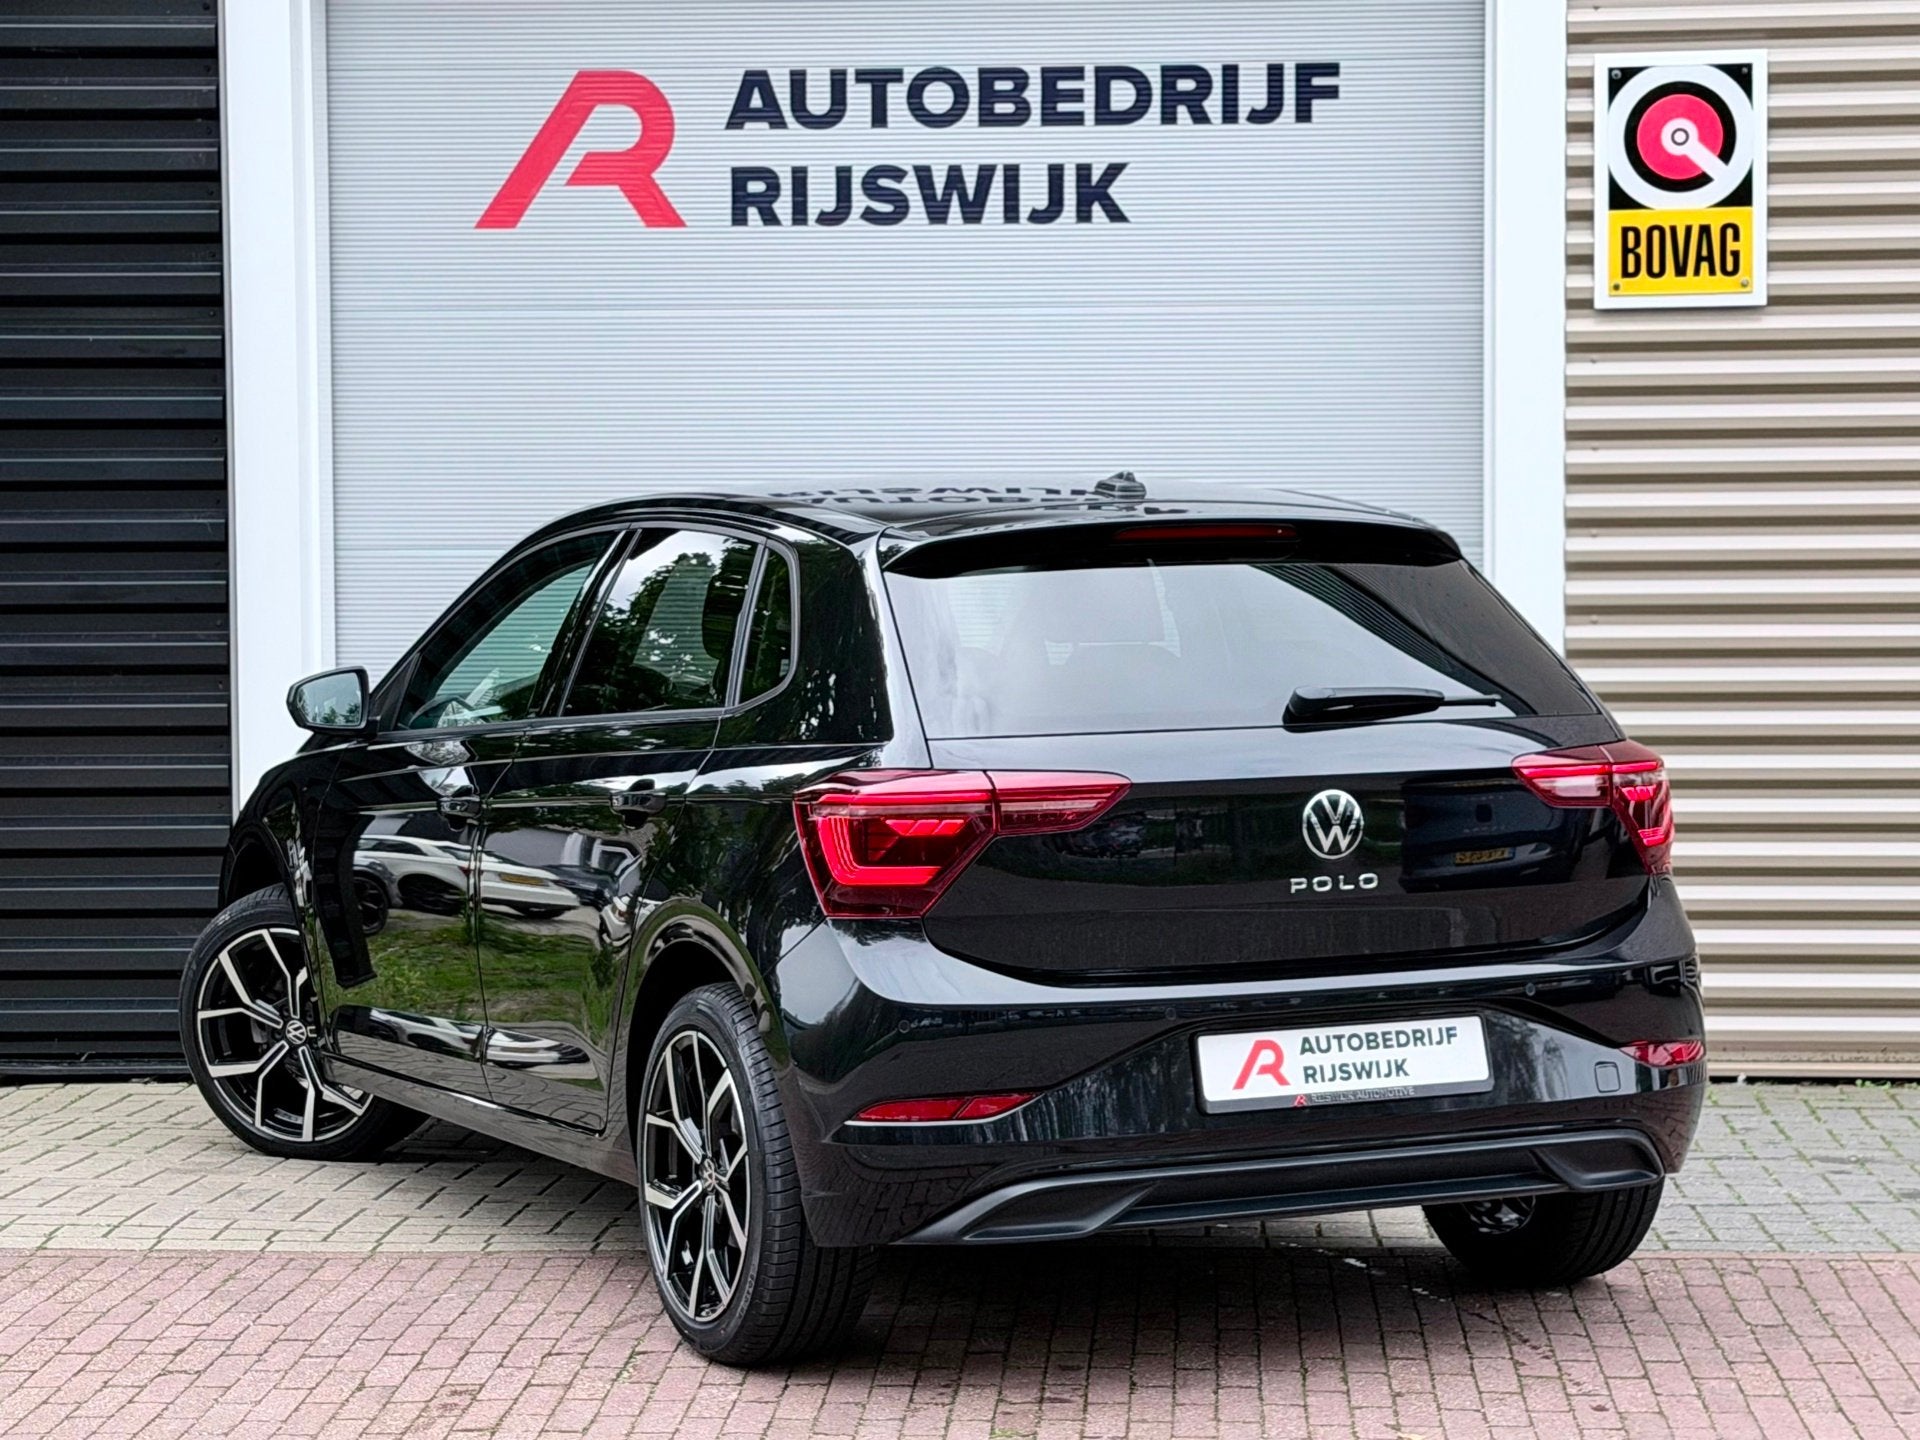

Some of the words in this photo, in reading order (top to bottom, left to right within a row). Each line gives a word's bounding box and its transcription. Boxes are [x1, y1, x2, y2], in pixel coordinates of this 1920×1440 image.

[725, 62, 1341, 129] AUTOBEDRIJF
[730, 162, 1131, 227] RIJSWIJK
[1621, 223, 1741, 279] BOVAG
[1290, 873, 1379, 894] POLO
[1299, 1026, 1458, 1056] AUTOBEDRIJF
[1302, 1058, 1411, 1084] RIJSWIJK
[1356, 1086, 1415, 1099] AUTOMOTIVE
